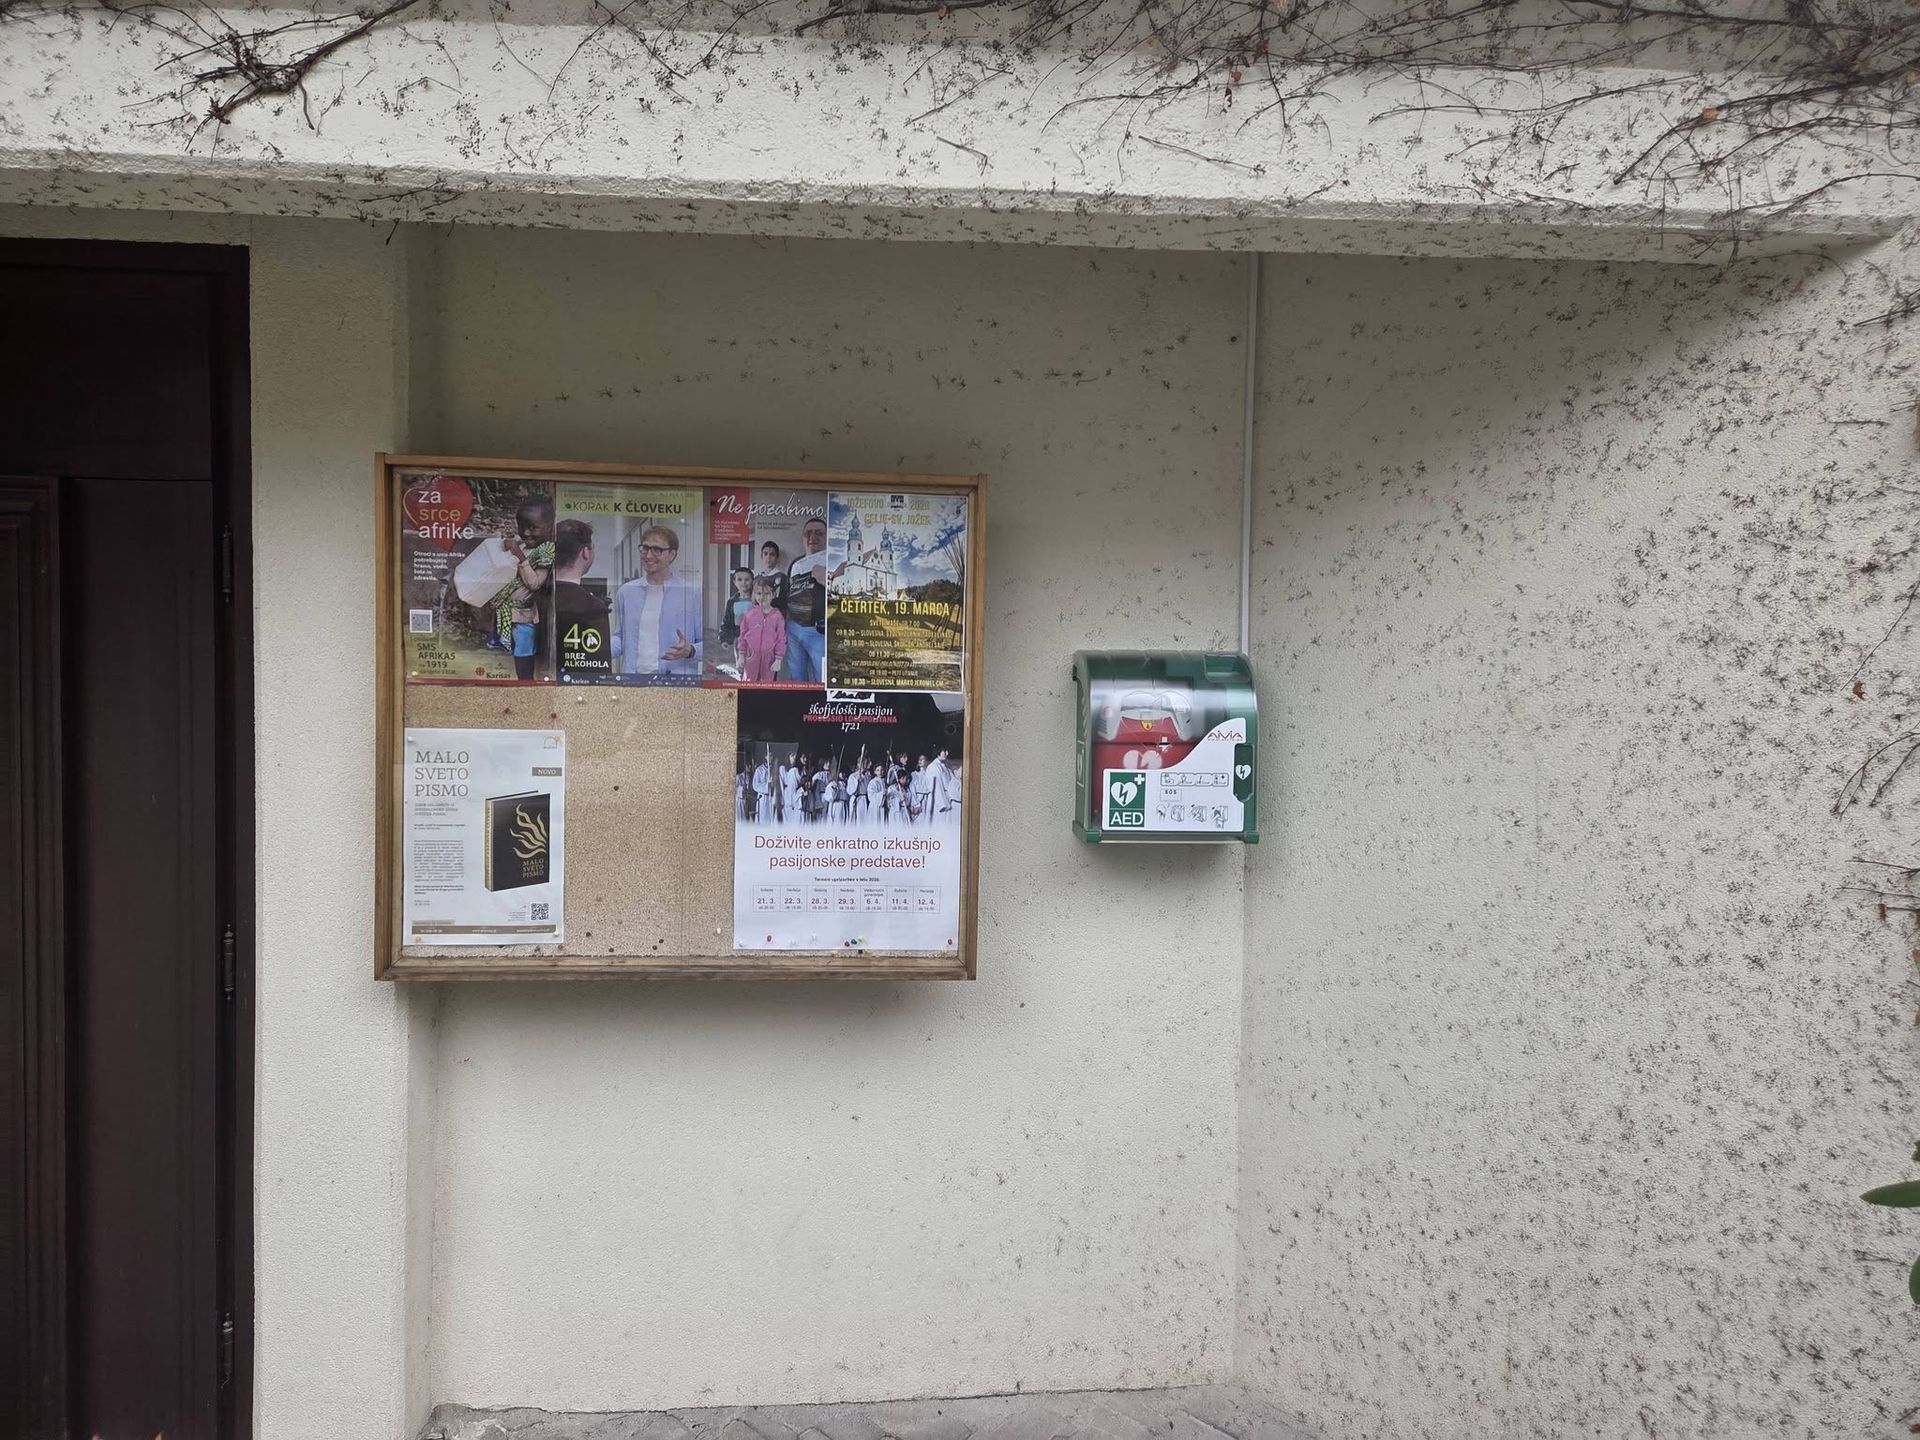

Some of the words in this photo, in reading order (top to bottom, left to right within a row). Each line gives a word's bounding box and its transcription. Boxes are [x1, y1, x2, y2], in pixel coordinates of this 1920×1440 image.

[418, 490, 441, 504] za
[573, 501, 610, 512] KORAK
[613, 502, 622, 513] K
[625, 500, 682, 514] ČLOVEKU
[717, 495, 743, 514] Ne
[419, 507, 461, 522] srce
[418, 522, 474, 540] afrike
[840, 598, 890, 615] ČETRTEK,
[895, 602, 910, 614] 19.
[912, 602, 950, 616] MARCA
[416, 642, 436, 651] SMS
[418, 651, 456, 660] AFRIKAS
[564, 652, 586, 660] BREZ
[426, 660, 448, 669] 1919
[564, 660, 609, 668] ALKOHOLA
[486, 671, 511, 679] Karitas
[808, 702, 857, 720] škofjeloški
[854, 704, 893, 720] pasijon
[840, 722, 860, 733] 1721
[415, 750, 470, 764] MALO
[414, 767, 469, 780] SVETO
[537, 768, 557, 776] NOVO
[414, 783, 469, 797] PISMO
[1110, 811, 1144, 826] AED
[754, 835, 812, 850] Doživite
[816, 836, 879, 850] enkratno
[883, 836, 941, 853] izkušnjo
[522, 858, 544, 867] MALO
[522, 864, 544, 873] SVETO
[769, 854, 846, 870] pasijonske
[850, 855, 926, 870] predstave!
[522, 870, 544, 878] PISMO
